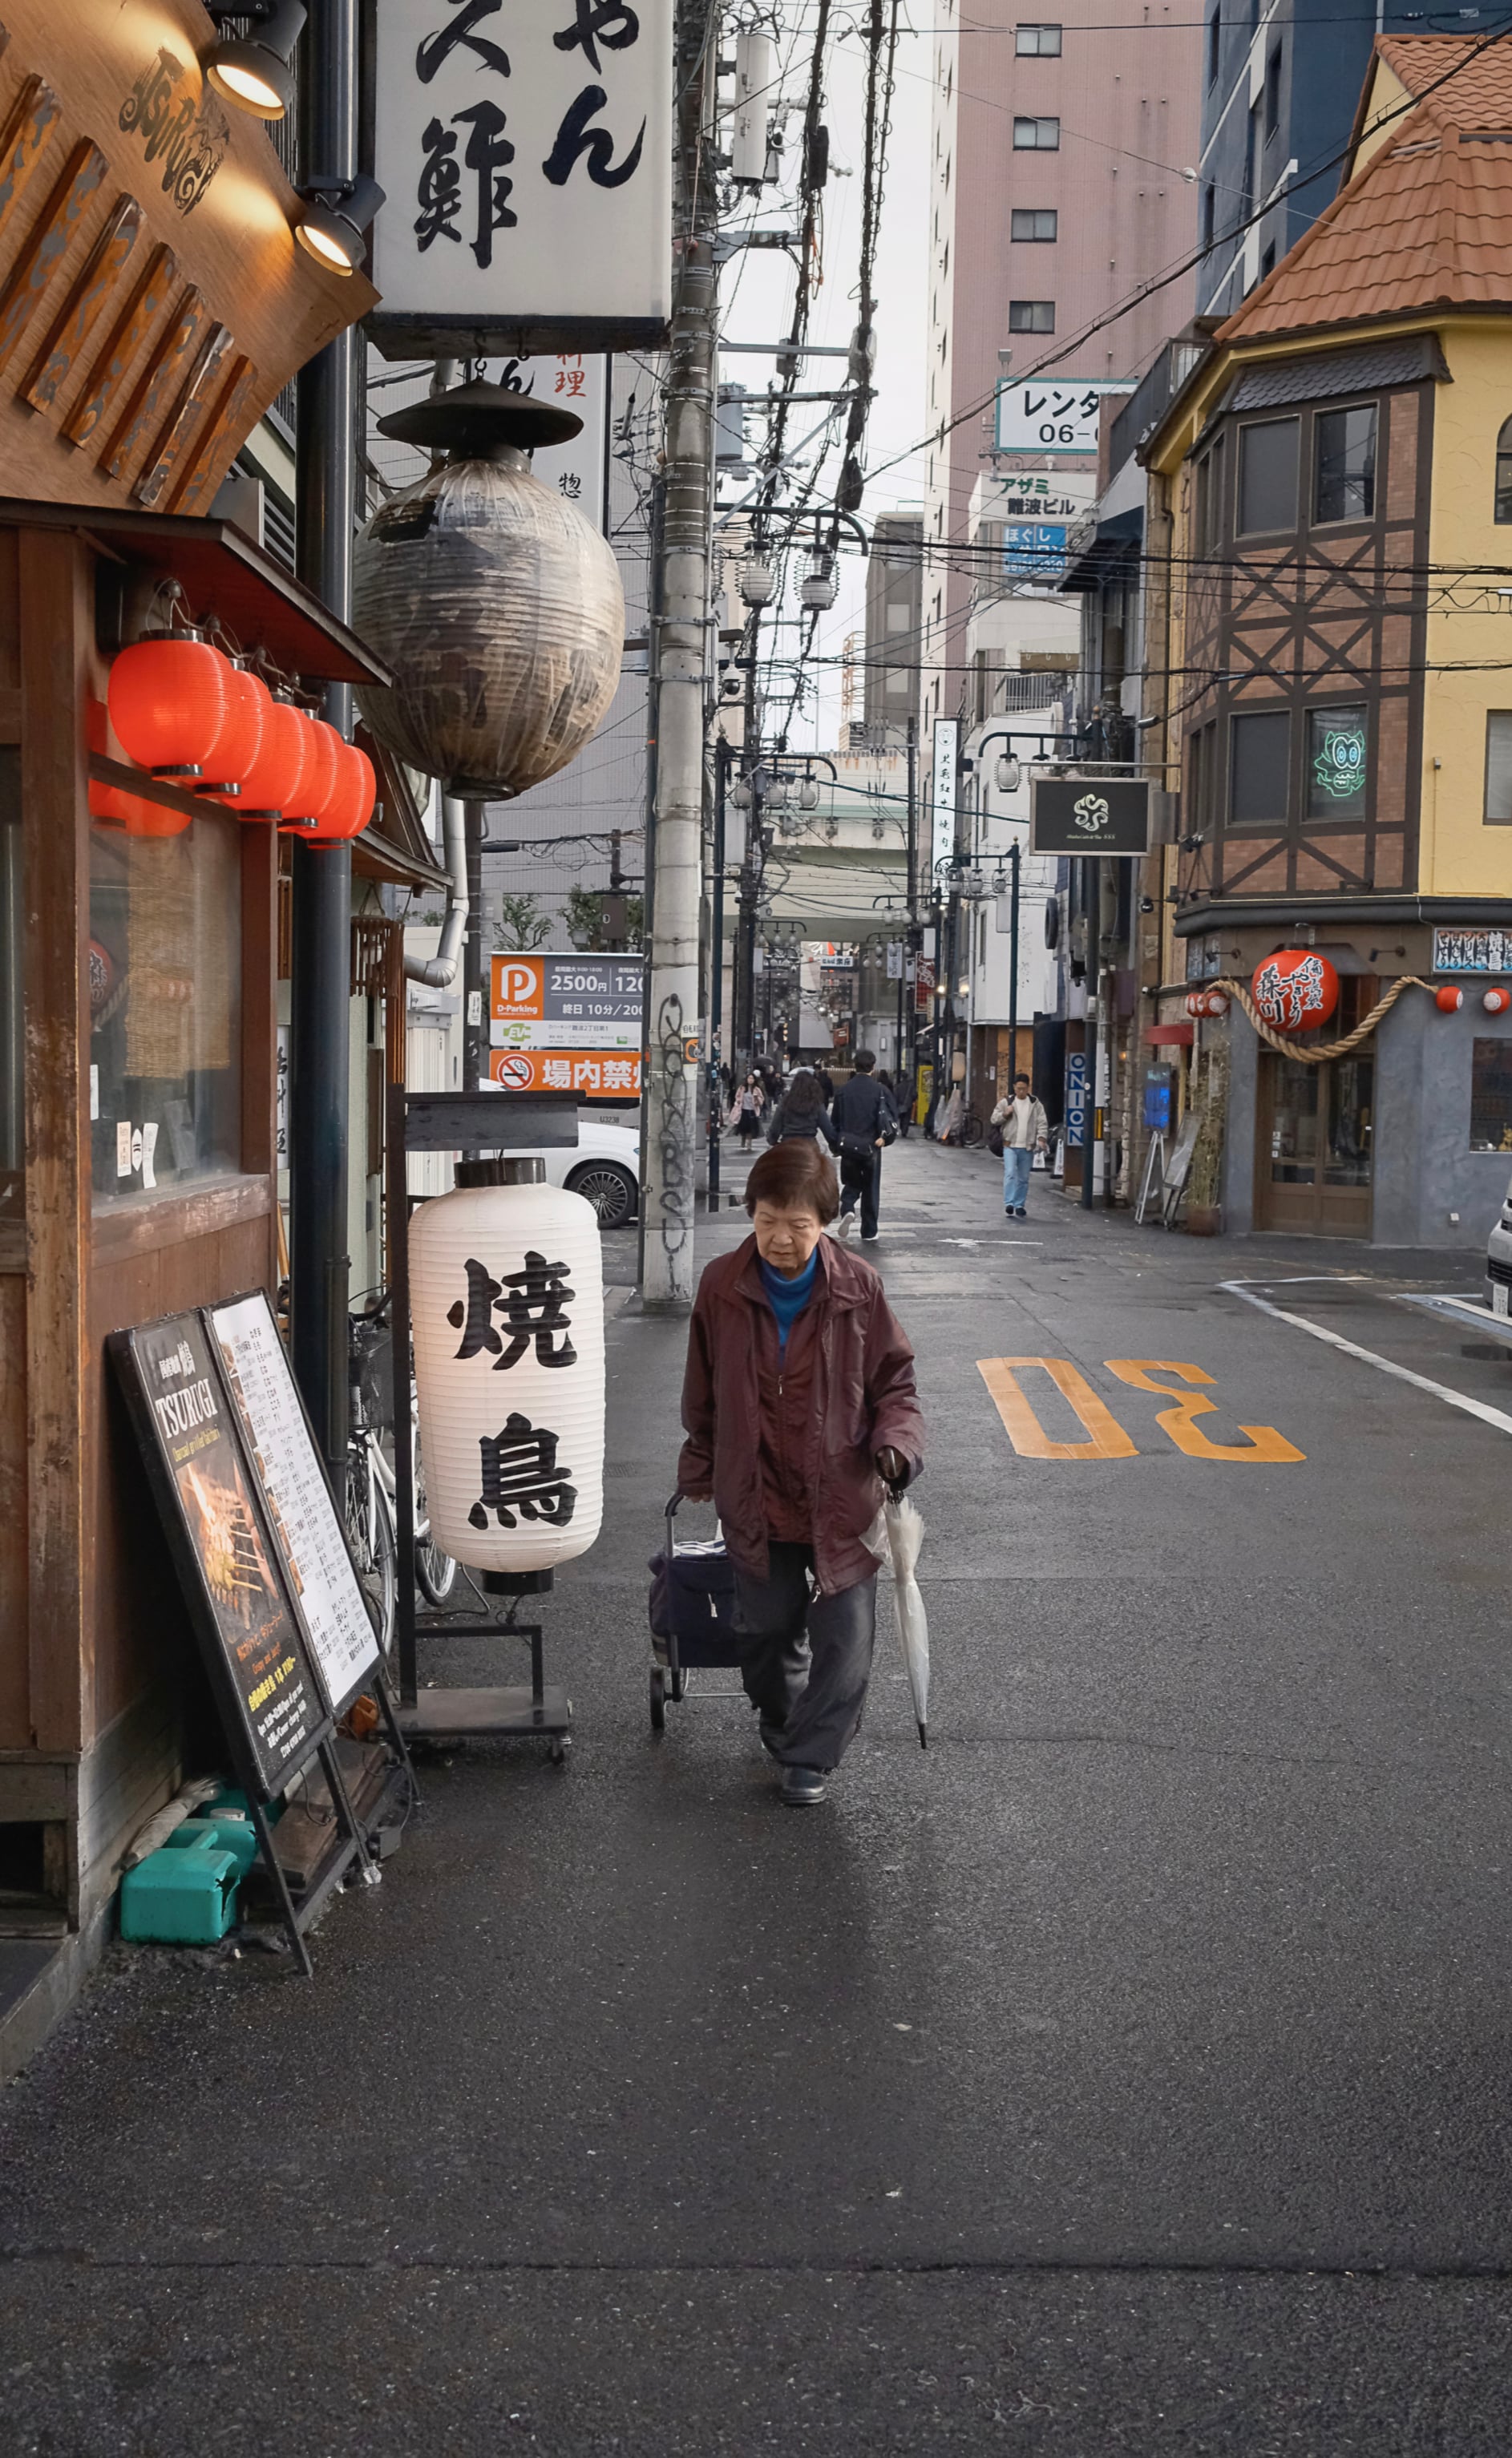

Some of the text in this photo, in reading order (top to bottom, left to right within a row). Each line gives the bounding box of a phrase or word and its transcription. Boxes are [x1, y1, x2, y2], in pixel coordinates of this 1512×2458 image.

[1039, 424, 1099, 443] 06-
[1001, 478, 1049, 495] アザミ
[1008, 498, 1075, 515] 難波ビル
[1005, 528, 1051, 543] ほぐし
[551, 975, 607, 992] 2500円
[1256, 962, 1289, 1025] 森川
[497, 1004, 538, 1015] D-Parking
[563, 1004, 583, 1014] 終日
[1069, 1054, 1085, 1144] ONION
[447, 1251, 578, 1530] 焼鳥
[155, 1378, 218, 1439] TSURUGI
[976, 1357, 1307, 1462] 30
